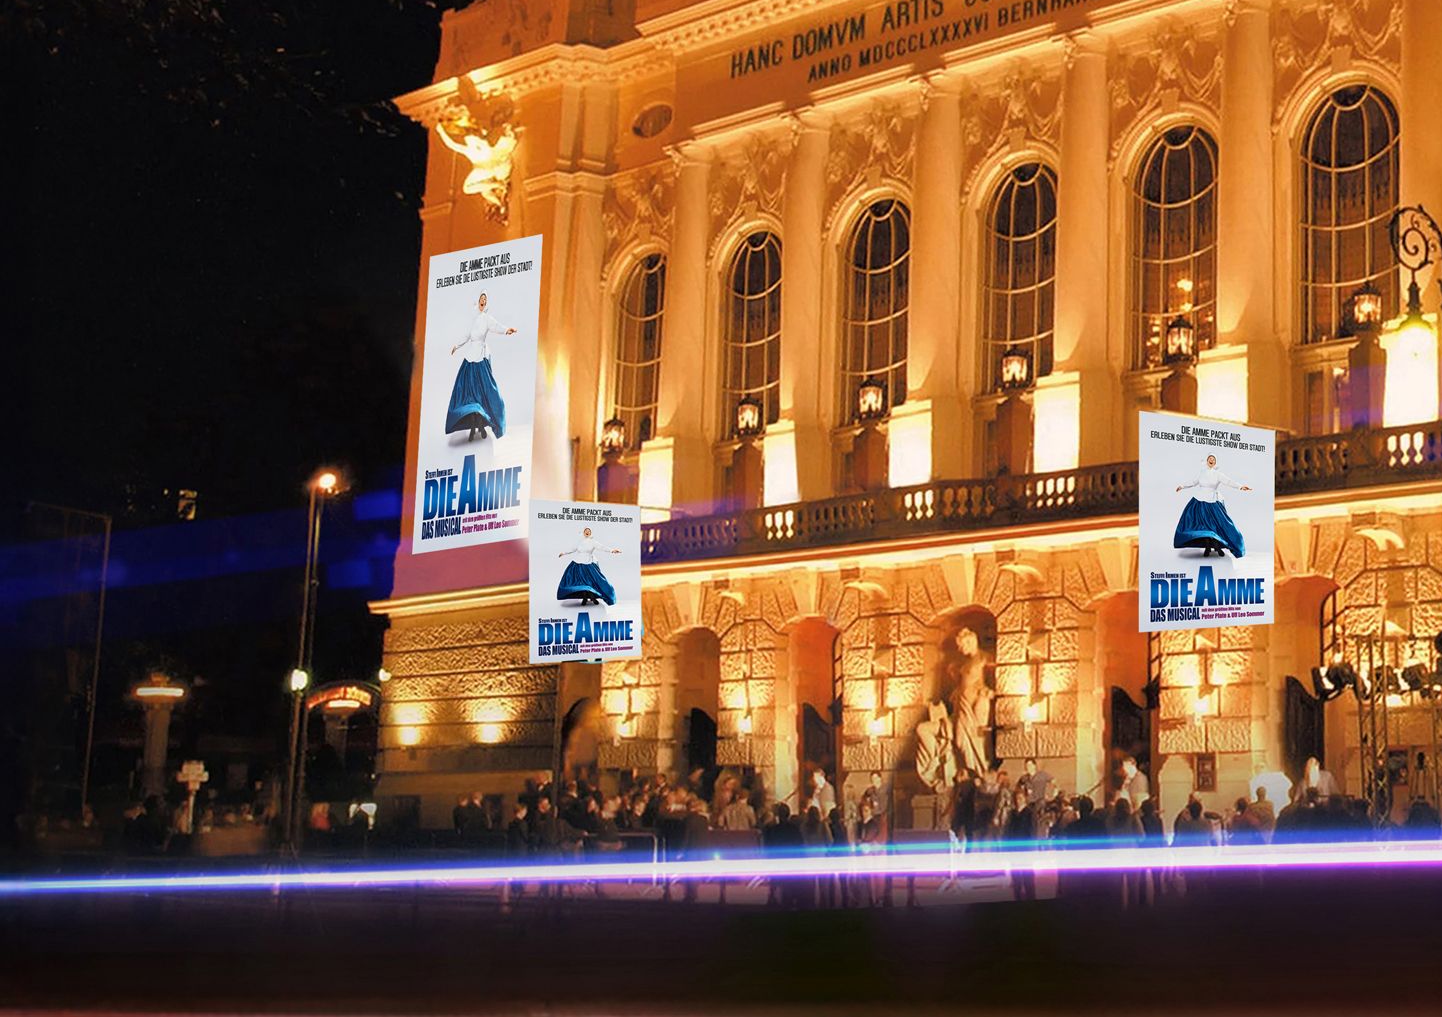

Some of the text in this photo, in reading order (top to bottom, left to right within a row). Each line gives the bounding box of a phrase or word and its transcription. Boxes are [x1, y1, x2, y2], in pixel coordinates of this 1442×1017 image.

[731, 40, 783, 78] HANC
[792, 13, 865, 60] DOMVM
[808, 55, 851, 84] ANNO
[859, 12, 989, 67] MDCCCLXXXXVI
[500, 252, 510, 265] AUS
[1150, 430, 1175, 441] ERLEBEN
[1176, 433, 1184, 442] SIE
[1186, 435, 1194, 443] DIE
[1224, 440, 1238, 449] SHOW
[1181, 426, 1240, 441] DIE AMME PACKT AUS
[422, 521, 434, 540] DAS
[435, 516, 461, 538] MUSICAL
[1150, 609, 1166, 622] DAS
[1167, 608, 1200, 622] MUSICAL
[538, 646, 551, 656] DAS
[552, 644, 579, 655] MUSICAL
